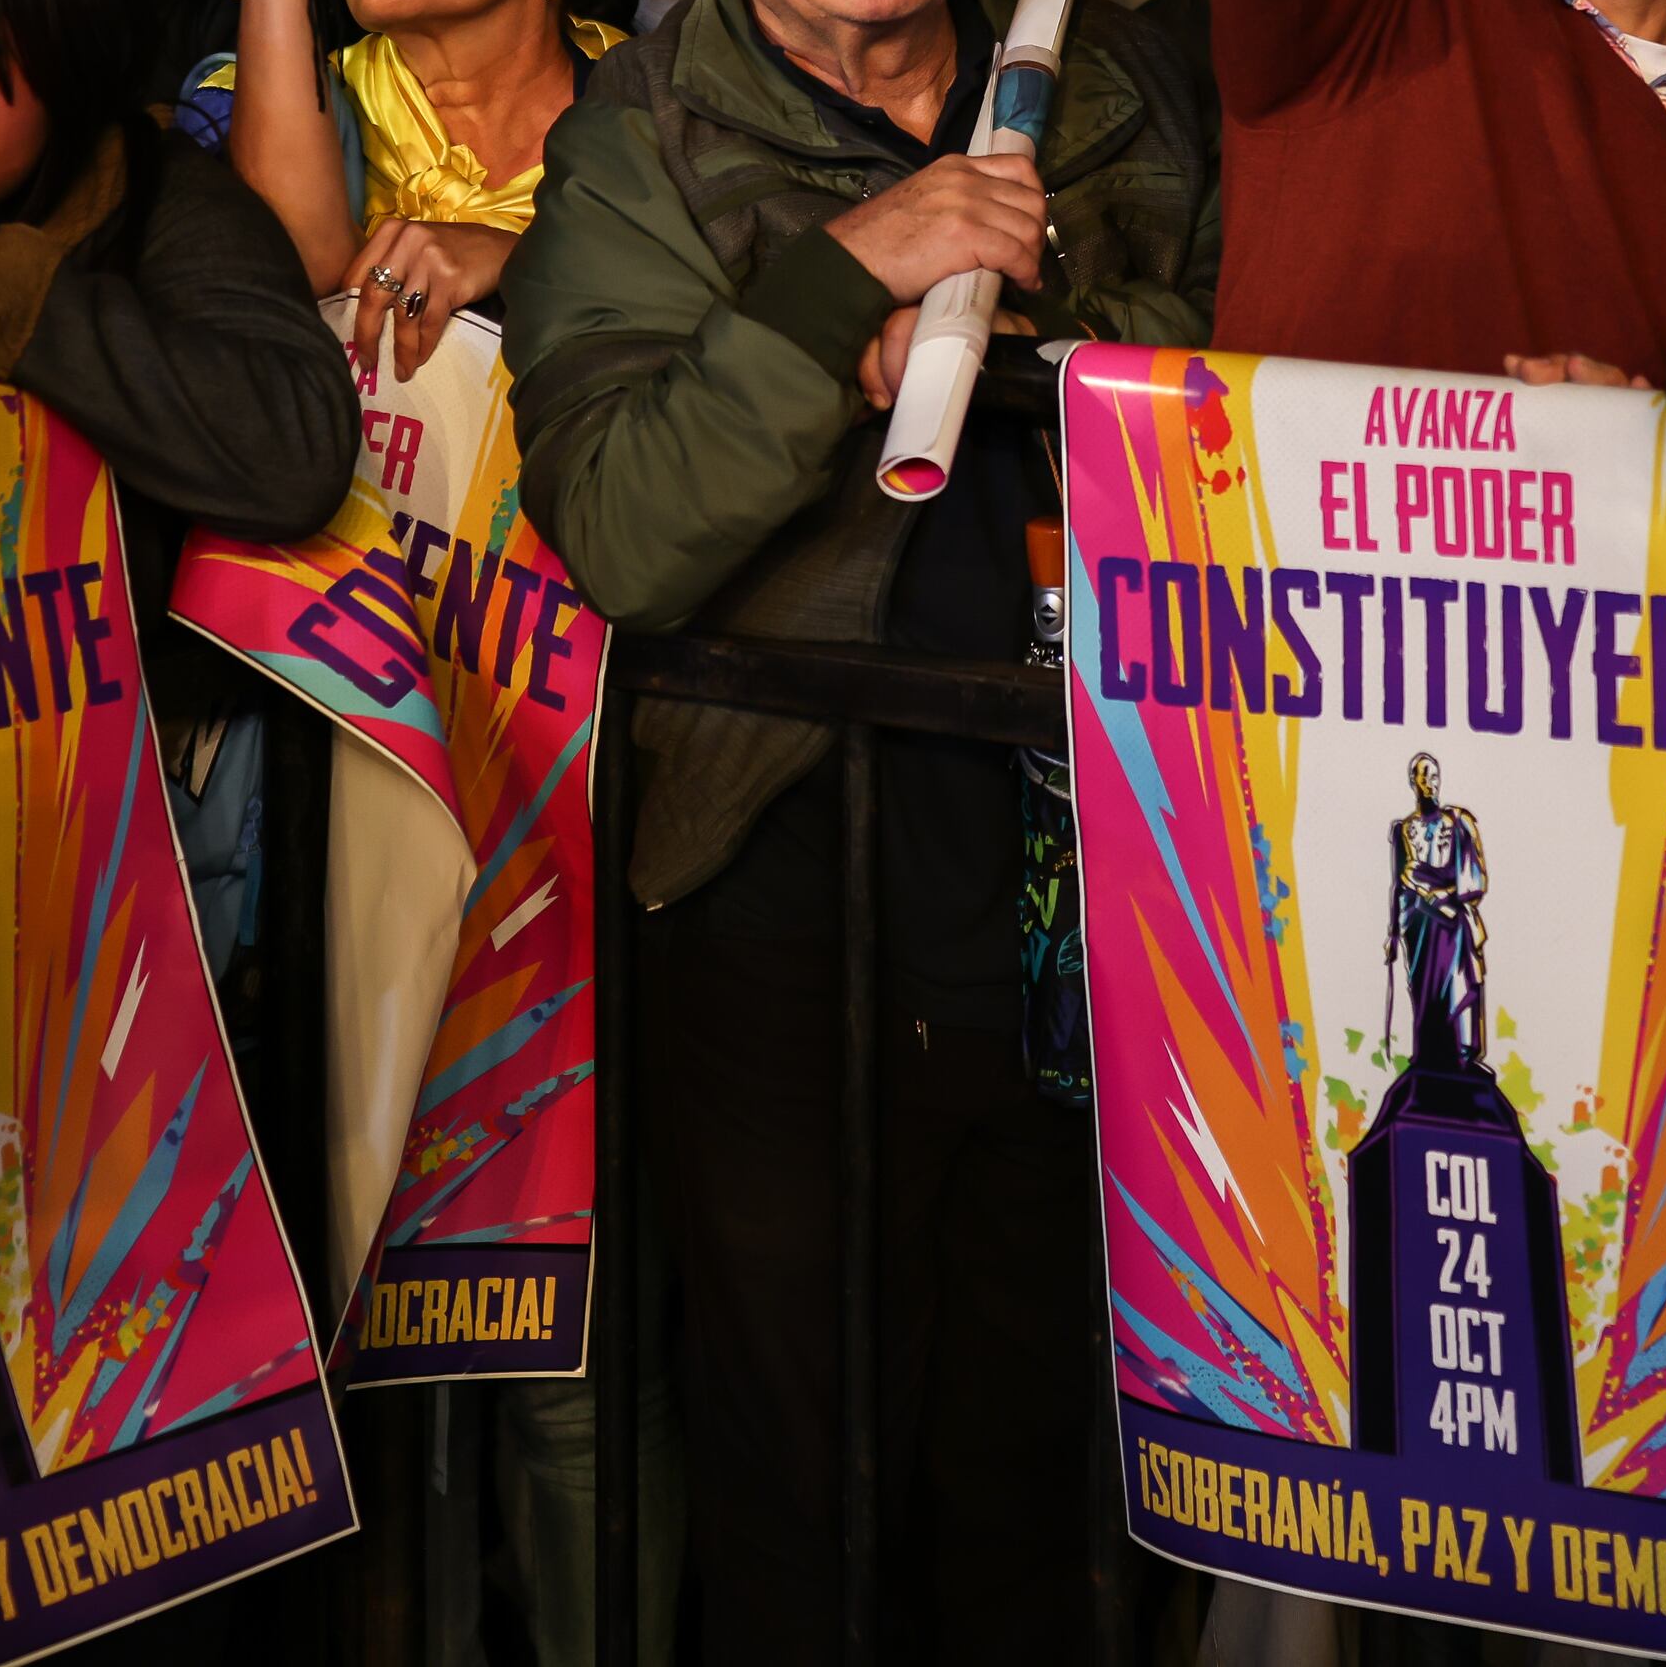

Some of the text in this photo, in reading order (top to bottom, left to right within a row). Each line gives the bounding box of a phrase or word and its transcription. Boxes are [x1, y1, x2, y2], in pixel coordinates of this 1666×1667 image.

[1363, 385, 1517, 453] AVANZA
[1318, 459, 1578, 567] EL PODER
[1424, 1149, 1498, 1226] COL
[1437, 1232, 1491, 1300] 24
[359, 1276, 557, 1350] OCRACIA!
[1428, 1303, 1506, 1378] OCT
[1428, 1380, 1519, 1456] 4PM
[24, 1425, 319, 1611] DEMOCRACIA!
[1137, 1440, 1392, 1581] ¡SOBERANÍA,
[1400, 1497, 1492, 1588] PAZ
[1502, 1515, 1538, 1594] Y
